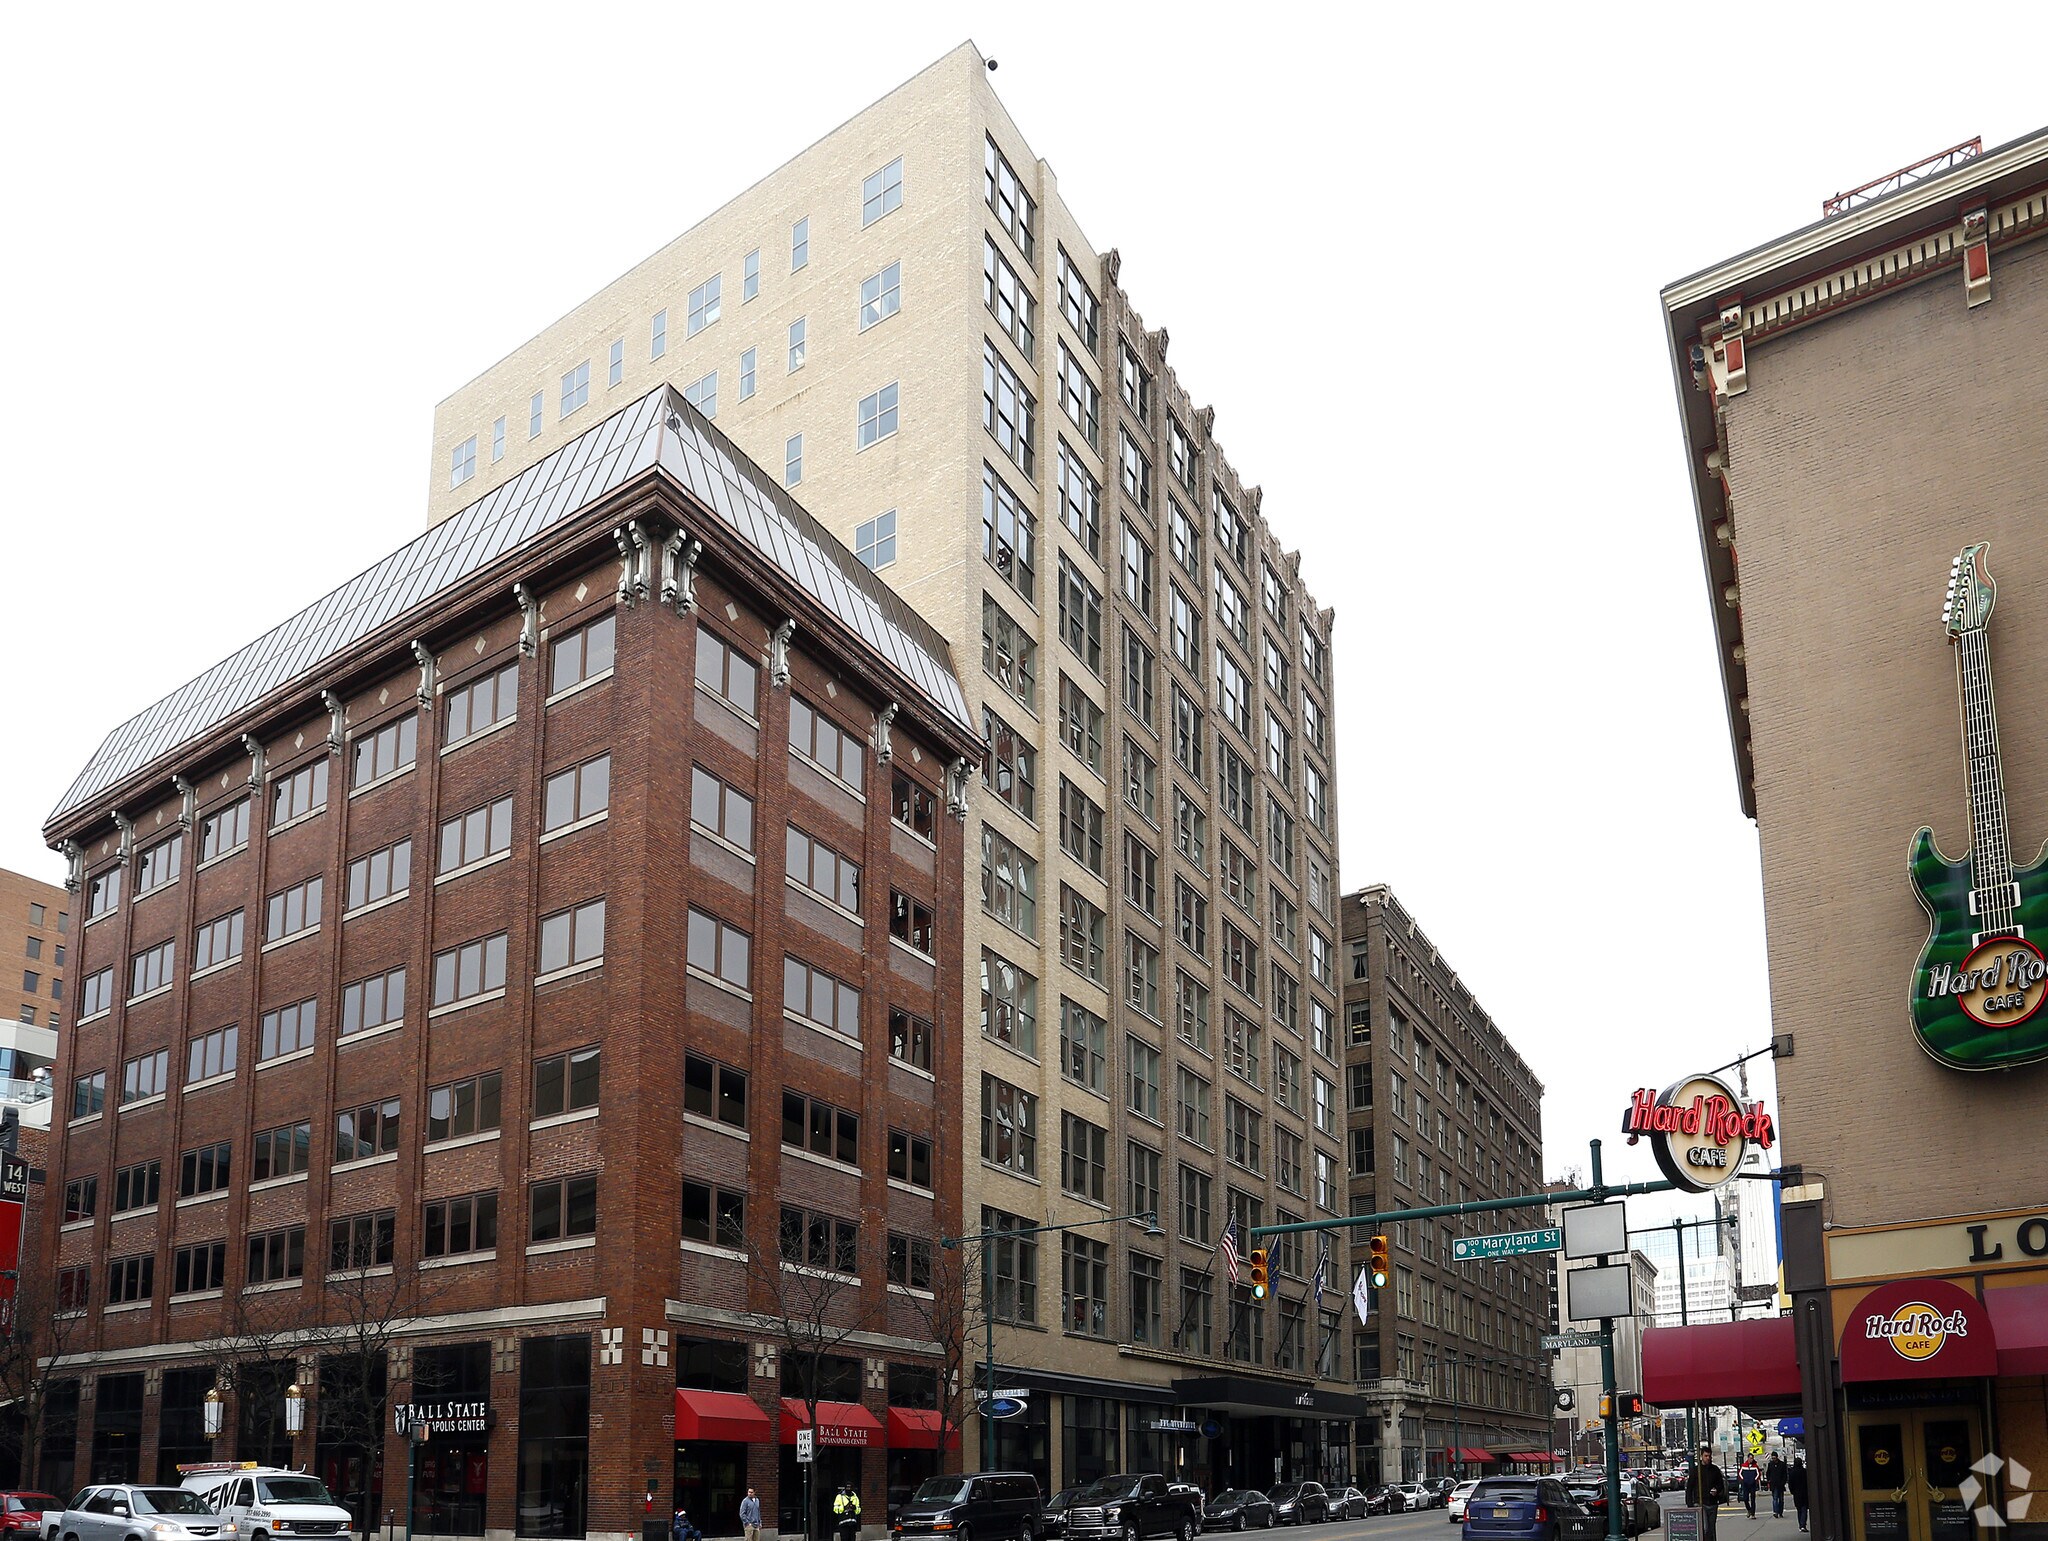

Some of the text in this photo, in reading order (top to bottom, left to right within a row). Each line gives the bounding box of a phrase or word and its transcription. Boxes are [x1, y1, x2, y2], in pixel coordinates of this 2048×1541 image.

[1927, 948, 2048, 998] Hard Ro
[1983, 991, 2025, 1014] CAFE
[1630, 1088, 1773, 1150] Hard Rock
[1687, 1146, 1728, 1168] CAFE
[7, 1164, 23, 1181] 14
[3, 1181, 26, 1195] WEST
[1467, 1231, 1556, 1250] 100 Maryland St
[1470, 1248, 1476, 1257] S
[1502, 1248, 1515, 1256] WAY
[1865, 1310, 1967, 1339] Hard Rock
[1545, 1338, 1590, 1349] MARYLAND
[1905, 1340, 1931, 1350] CAFE
[408, 1401, 486, 1420] BALL STATE
[457, 1419, 486, 1432] CENTER
[844, 1427, 868, 1438] STATE
[798, 1432, 810, 1441] ONE
[798, 1443, 811, 1451] WAY
[198, 1477, 240, 1510] EM
